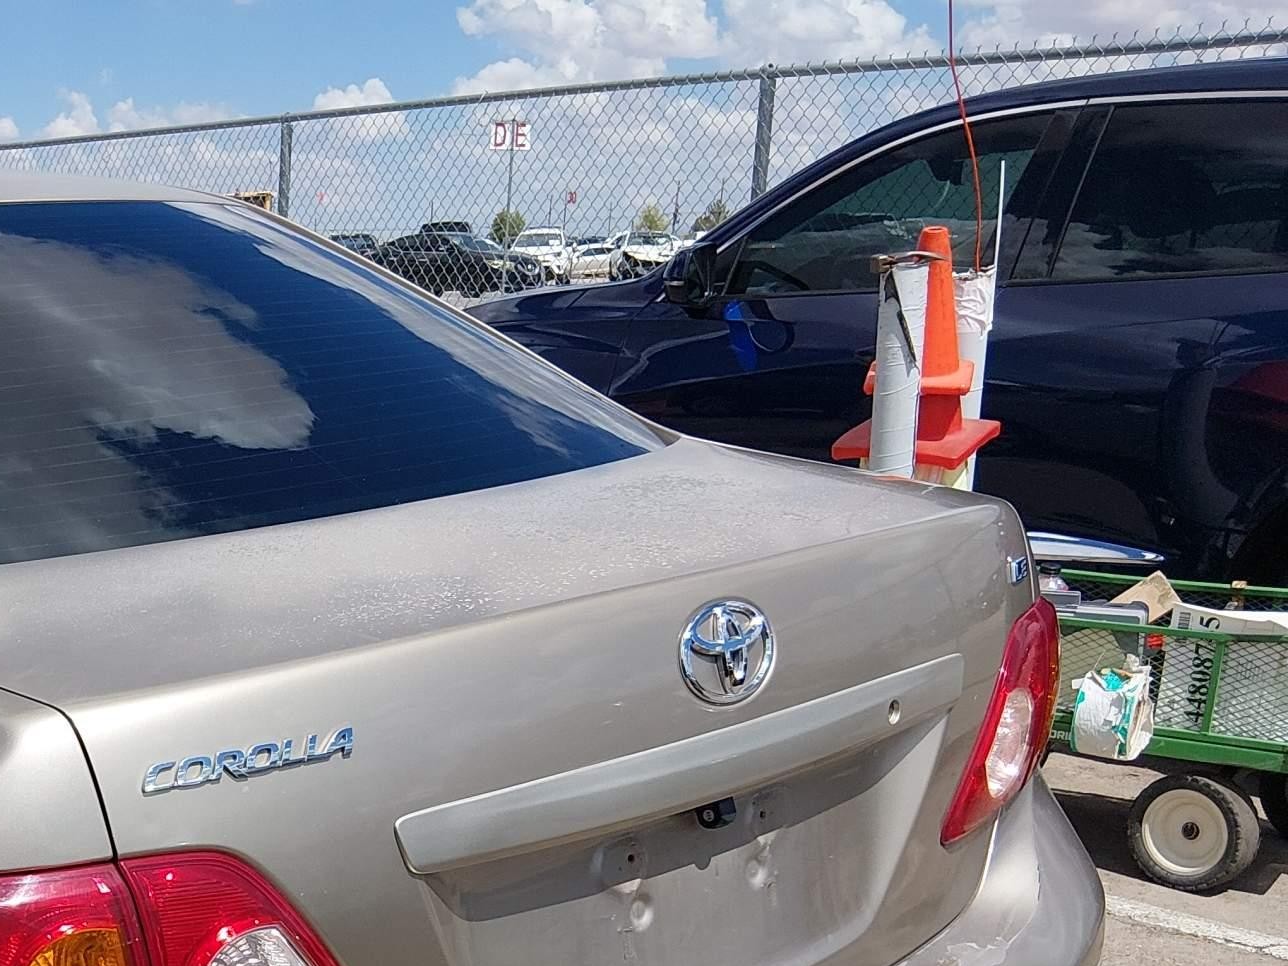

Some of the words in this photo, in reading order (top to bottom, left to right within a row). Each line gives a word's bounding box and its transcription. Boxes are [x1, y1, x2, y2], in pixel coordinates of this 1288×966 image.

[1009, 555, 1028, 584] LE
[1183, 615, 1222, 723] 4480875
[142, 727, 354, 797] COROLLA
